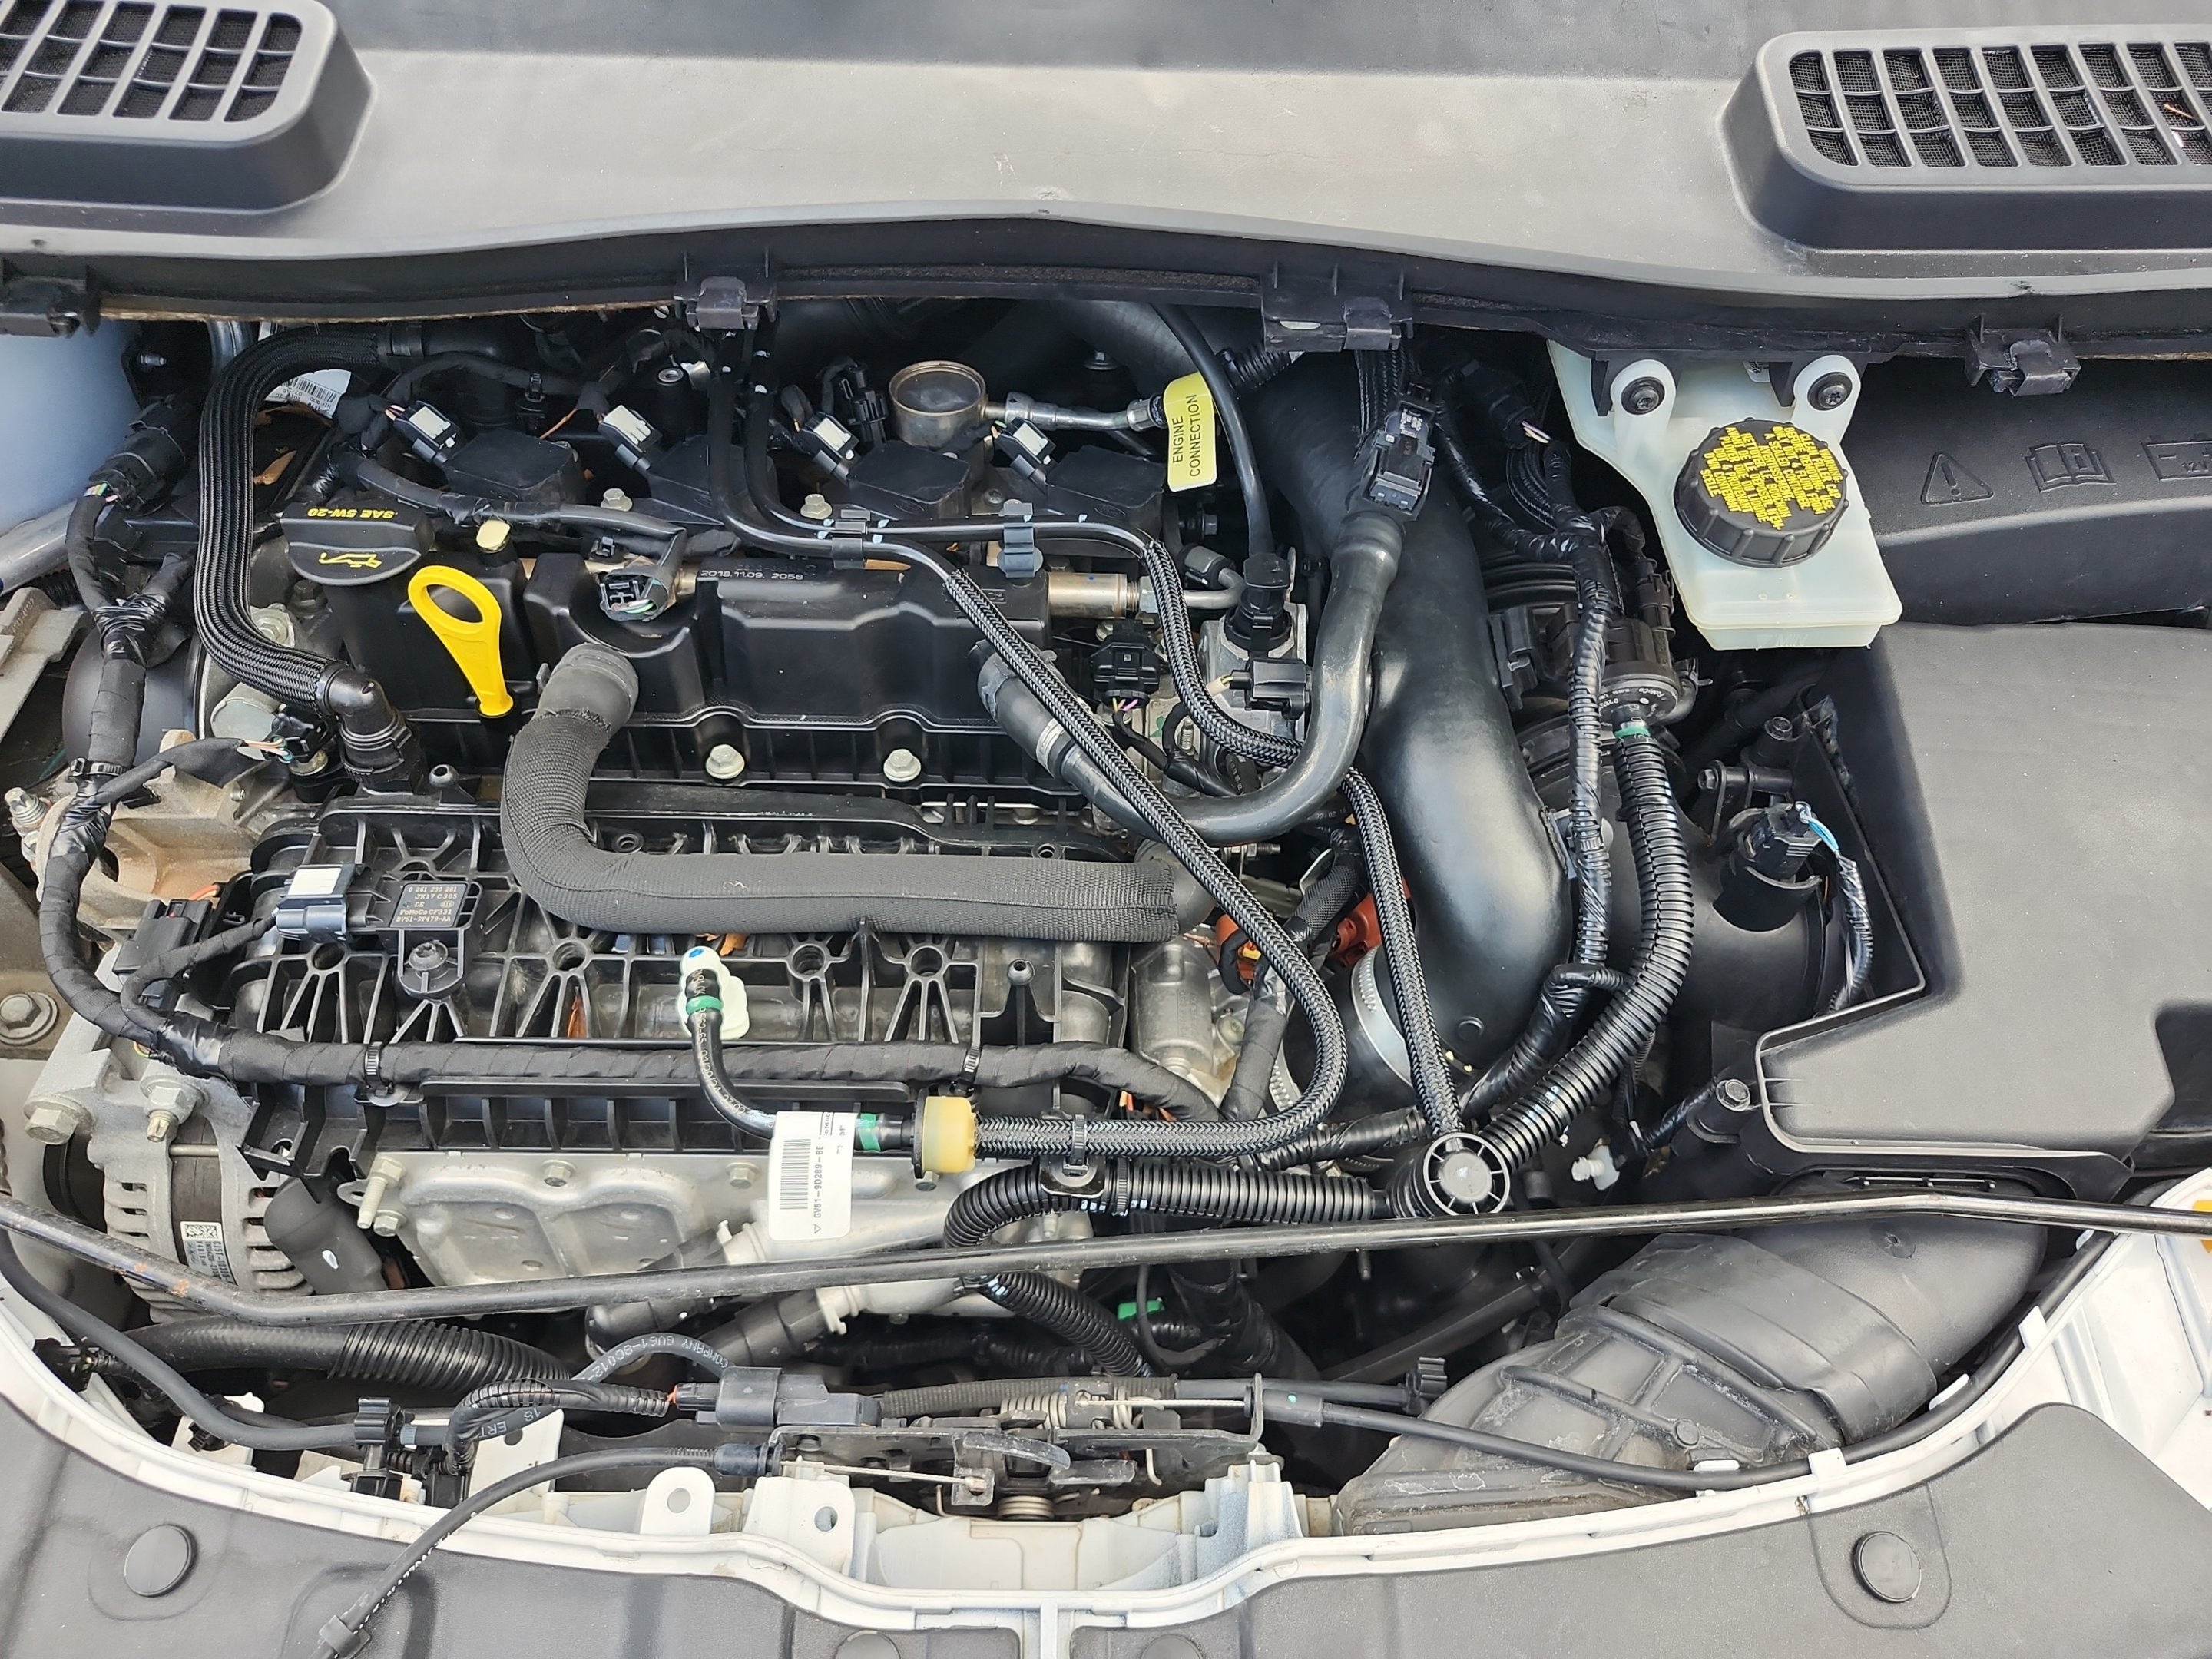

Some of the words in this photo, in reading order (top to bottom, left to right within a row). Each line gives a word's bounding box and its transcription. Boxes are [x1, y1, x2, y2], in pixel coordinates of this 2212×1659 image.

[1171, 416, 1183, 463] ENGINE
[1185, 394, 1200, 477] CONNECTION
[1720, 436, 1740, 462] PLOYER
[1726, 428, 1745, 448] AVANT
[1738, 450, 1751, 459] DE
[1743, 462, 1757, 472] LE
[1769, 442, 1790, 466] SEALED
[1800, 433, 1818, 458] CLEAN
[1812, 457, 1832, 485] FILLER
[1826, 484, 1841, 498] CAP
[1714, 448, 1729, 462] DOT
[1726, 472, 1753, 512] PROVENANT
[1734, 465, 1748, 478] QUE
[1741, 433, 1766, 468] NETTOYER
[1759, 470, 1773, 479] LE
[1767, 484, 1792, 517] BOUCHON
[1773, 426, 1790, 444] ONLY
[1783, 445, 1798, 459] DOT
[1795, 470, 1813, 490] FLUID
[1806, 493, 1826, 514] FROM
[1784, 427, 1805, 452] BEFORE
[1820, 495, 1835, 510] USE
[1714, 472, 1740, 511] CONTENANT
[1741, 481, 1754, 491] DU
[308, 508, 356, 518] 5W-20
[360, 510, 394, 519] SAE
[1747, 494, 1770, 522] LIQUIDE
[813, 1146, 823, 1217] GV61-9D289-BE
[682, 1337, 728, 1369] COMPANY
[524, 1408, 541, 1422] 18
